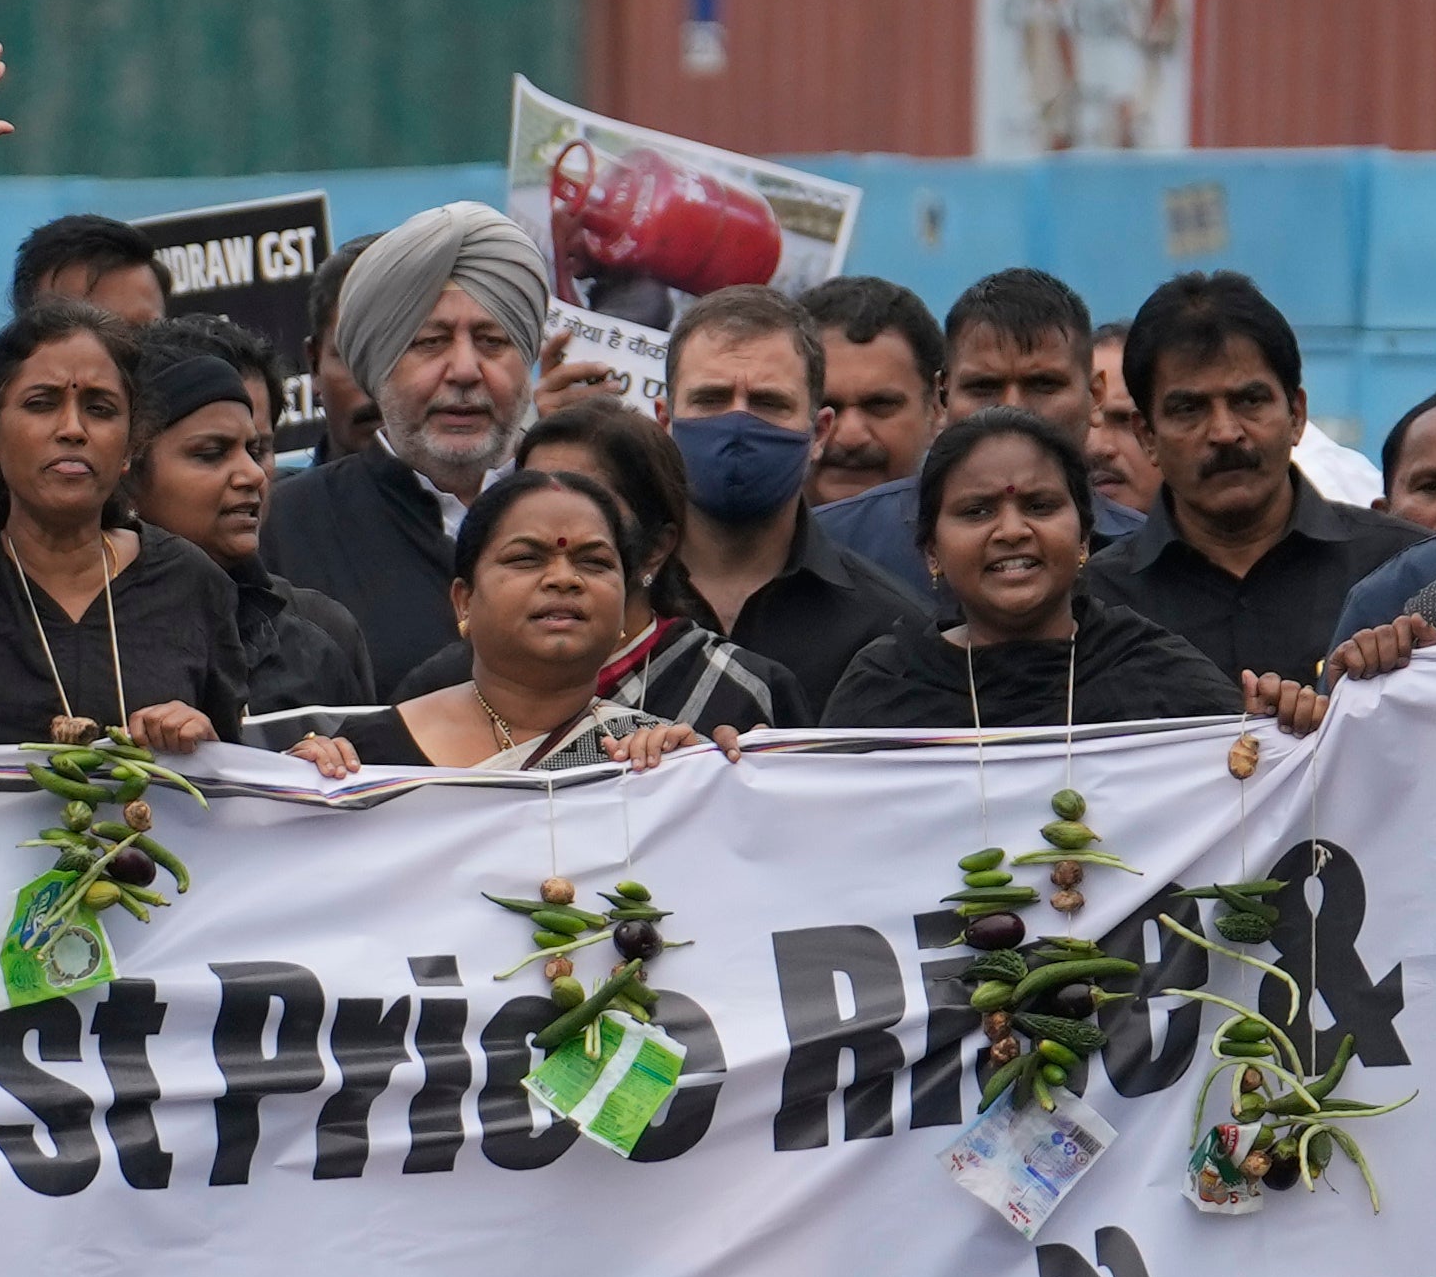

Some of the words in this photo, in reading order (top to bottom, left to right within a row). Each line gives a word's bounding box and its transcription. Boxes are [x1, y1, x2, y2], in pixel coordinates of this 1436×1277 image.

[259, 226, 316, 280] GST
[771, 881, 1210, 1153] Rie
[1257, 838, 1411, 1070] &
